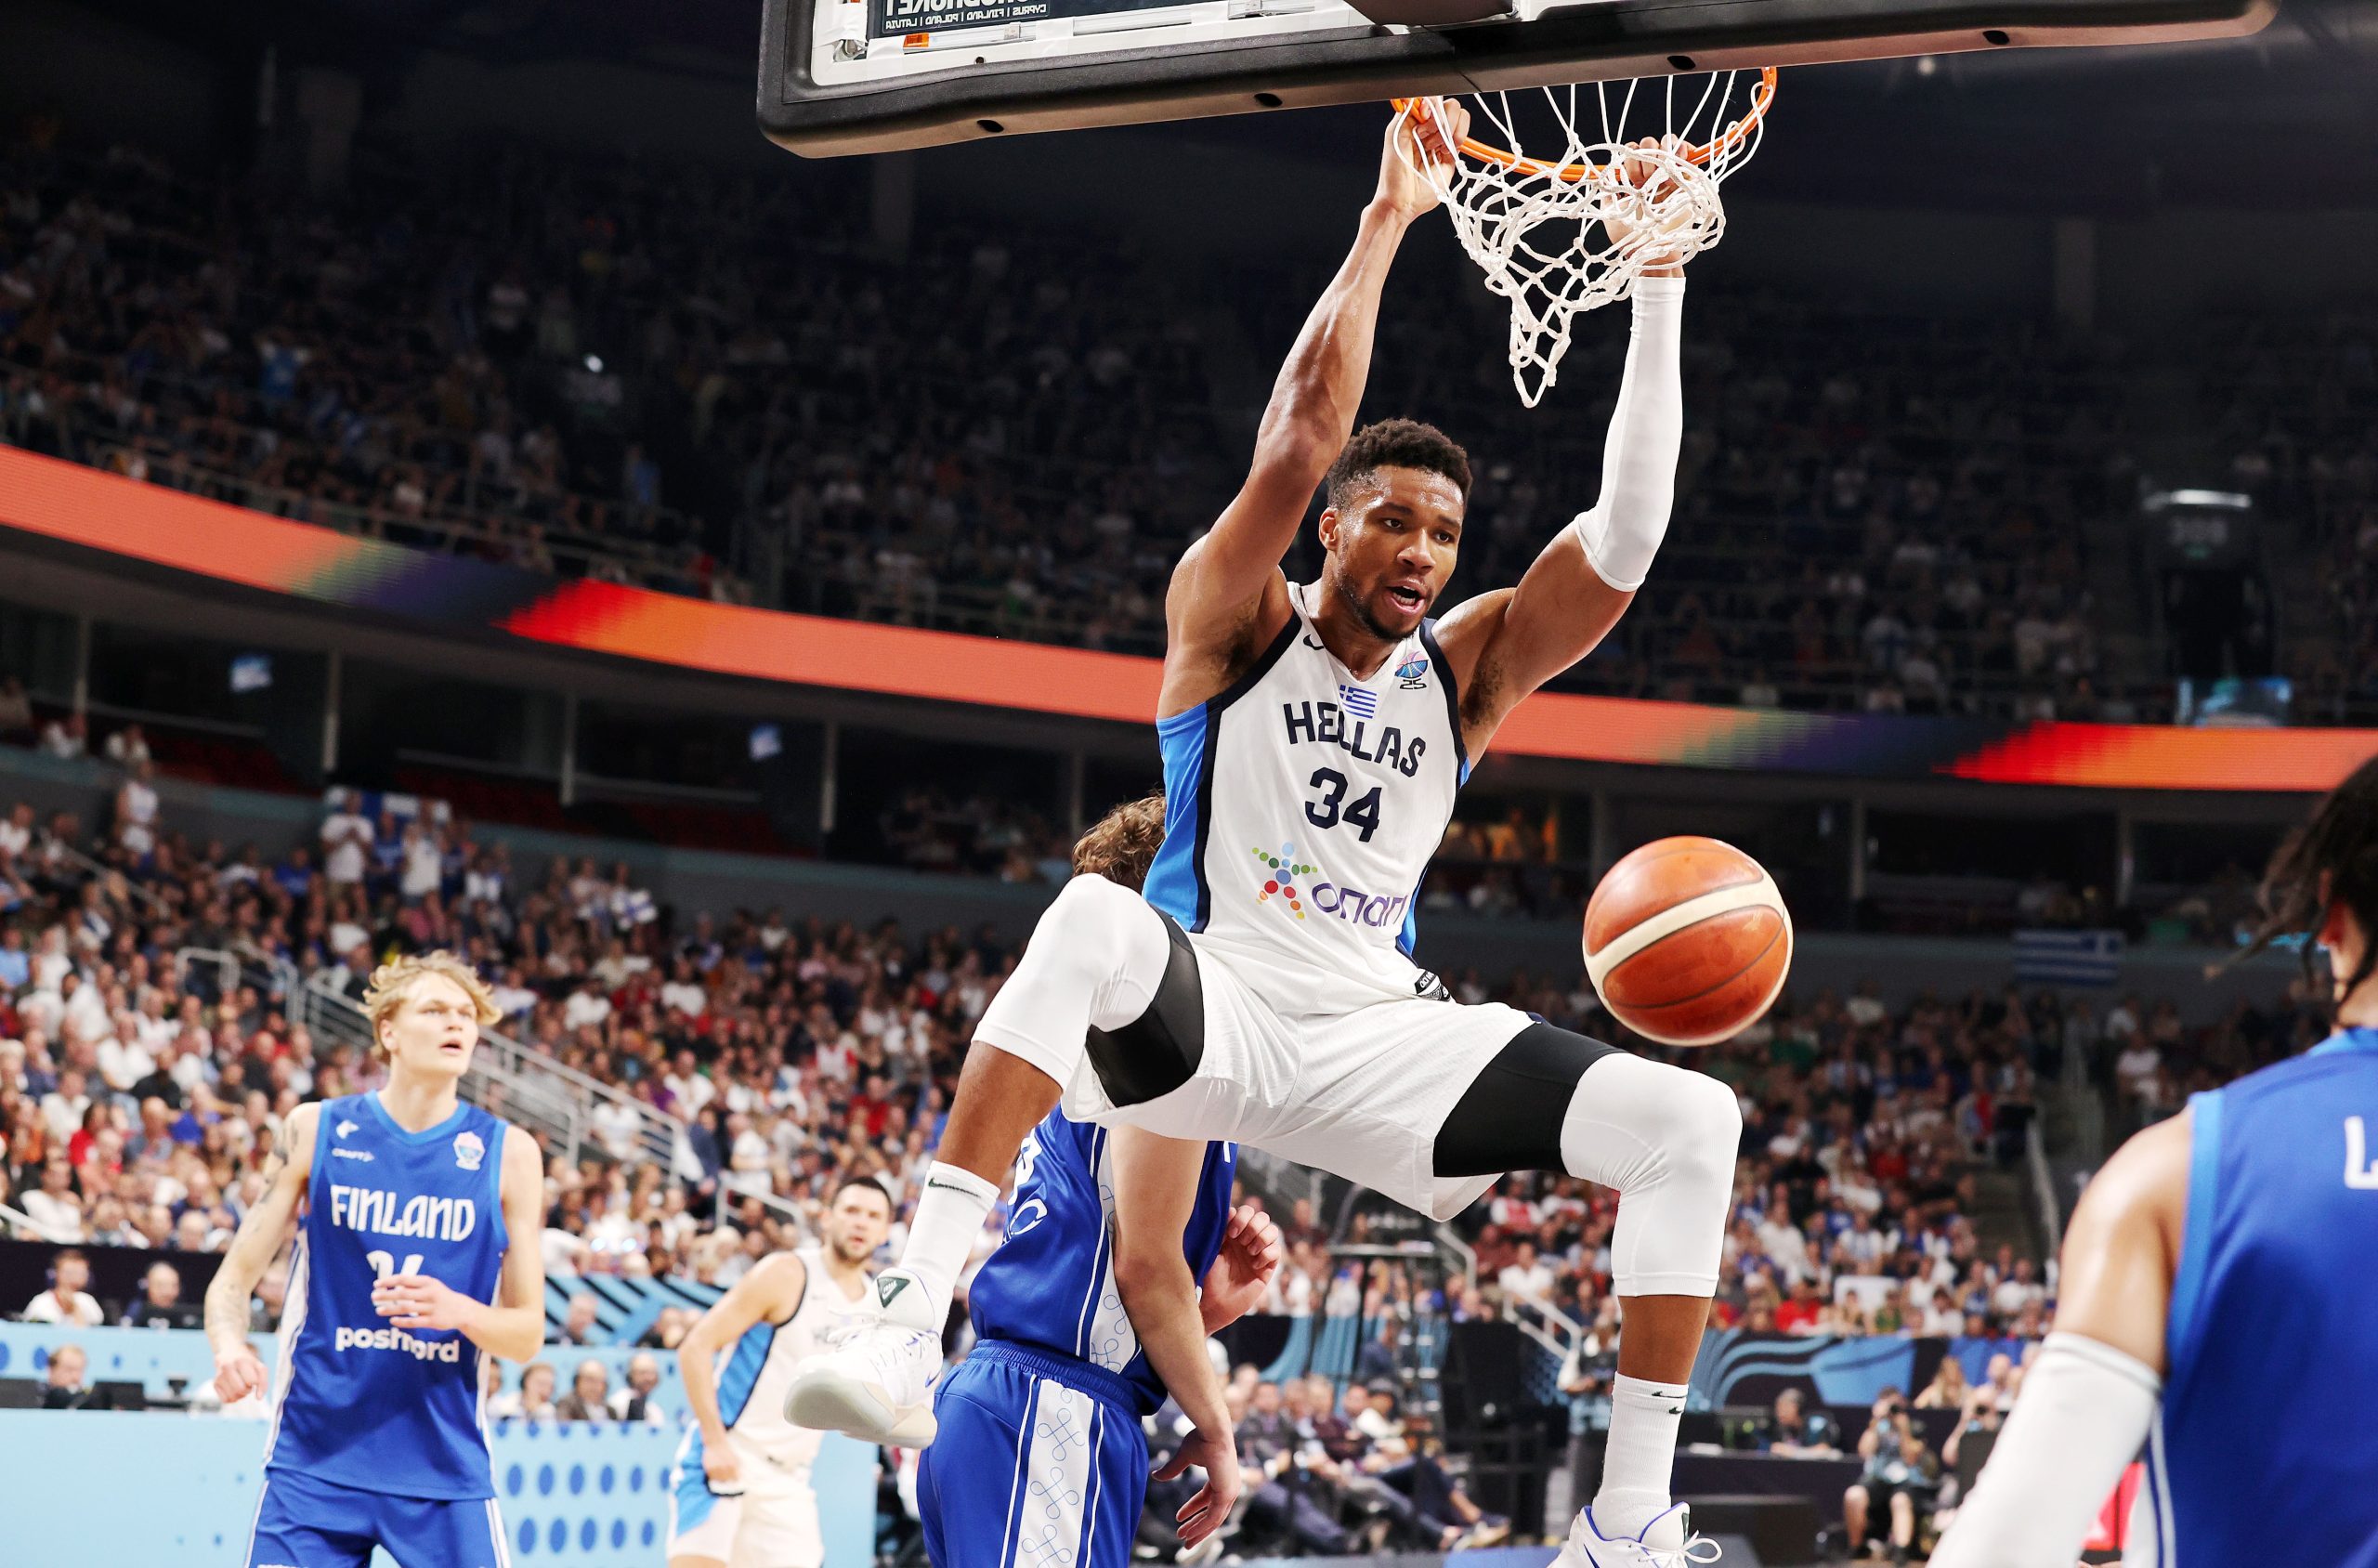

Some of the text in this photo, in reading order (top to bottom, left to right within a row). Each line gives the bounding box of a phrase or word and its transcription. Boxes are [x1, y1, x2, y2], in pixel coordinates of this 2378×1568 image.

[1283, 701, 1426, 777] HELLAS
[1305, 766, 1382, 843] 34
[331, 1184, 476, 1242] FINLAND
